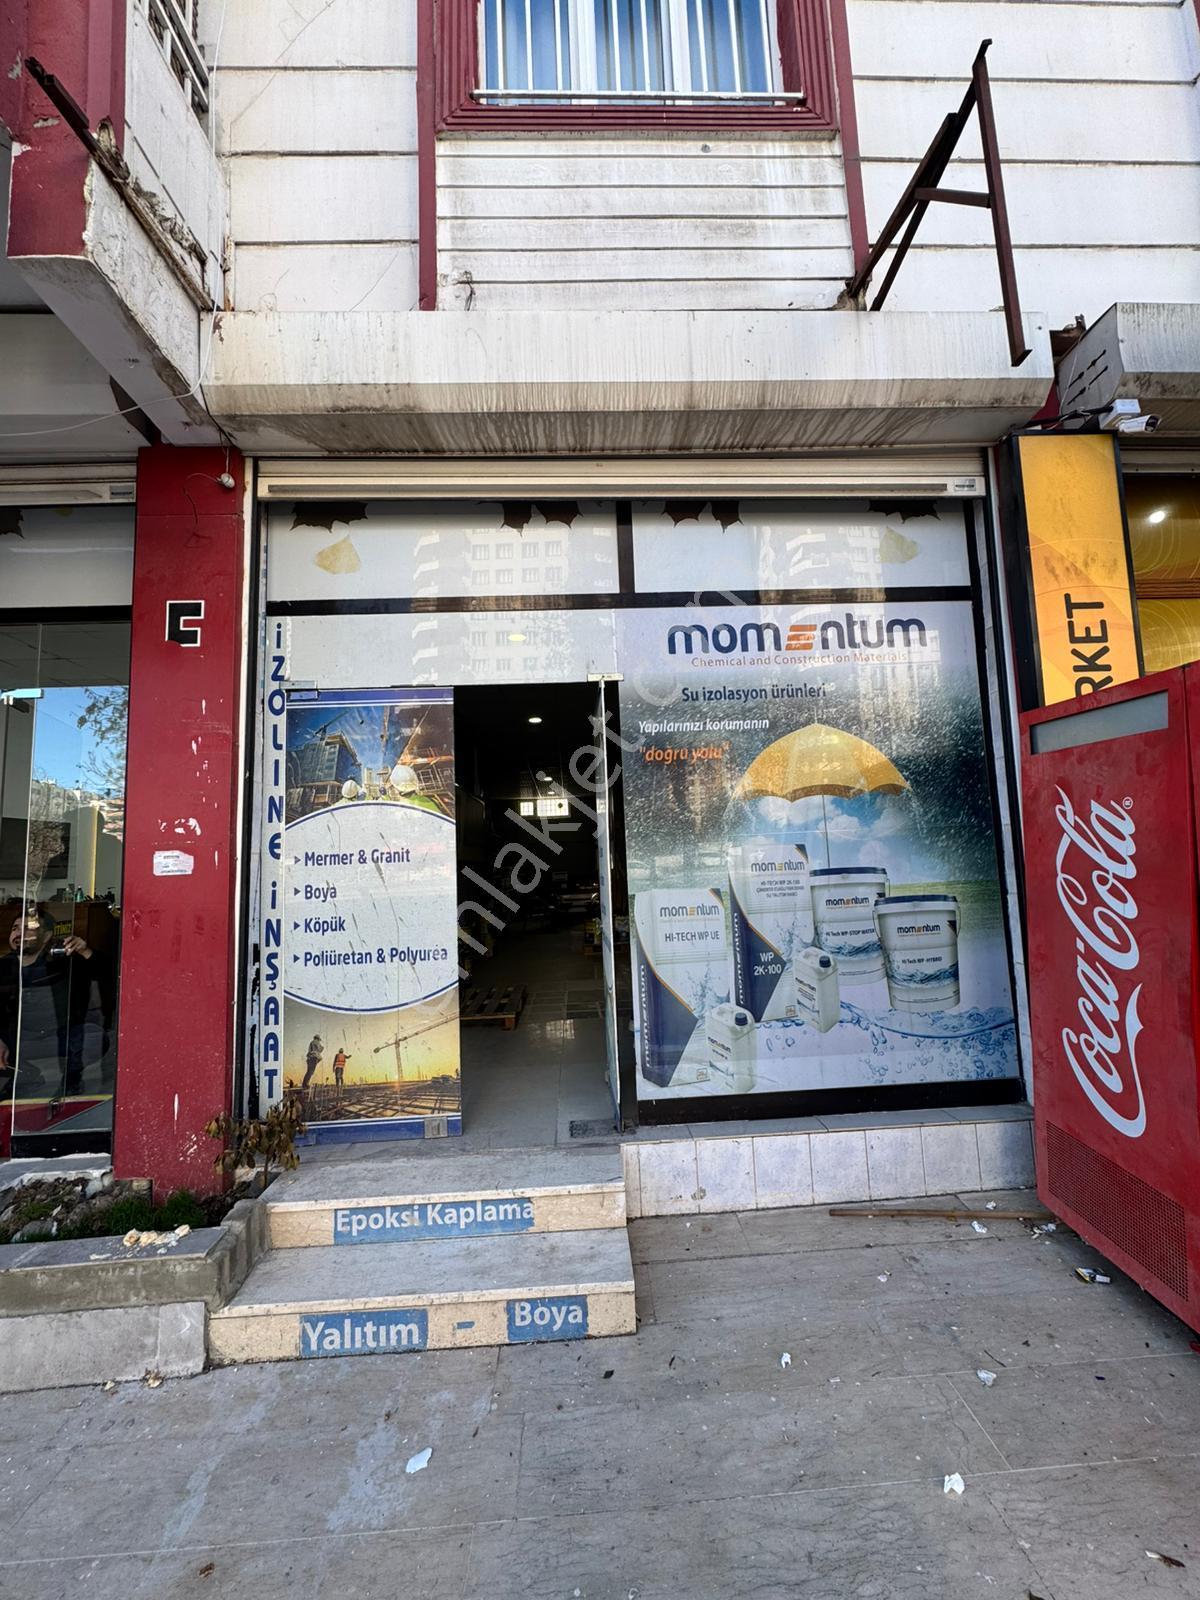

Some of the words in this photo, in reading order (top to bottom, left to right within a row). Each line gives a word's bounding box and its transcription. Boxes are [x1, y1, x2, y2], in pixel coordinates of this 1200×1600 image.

[668, 612, 928, 655] momentum
[691, 655, 747, 668] Chemical
[749, 655, 771, 667] and
[774, 653, 851, 666] Construction
[853, 652, 907, 664] Materials
[681, 687, 699, 702] Su
[702, 685, 768, 703] izolasyon
[771, 682, 827, 699] ürünleri
[638, 719, 704, 736] Yapılarınızı
[705, 718, 770, 731] korumanın
[304, 851, 354, 867] Mermer
[357, 850, 367, 864] &
[371, 847, 411, 864] Granit
[304, 884, 337, 903] Boya
[304, 916, 346, 936] Köpük
[664, 931, 697, 942] HI-TECH
[697, 931, 710, 941] WP
[710, 930, 720, 940] UE
[304, 950, 373, 967] Poliüretan
[376, 948, 386, 963] &
[759, 952, 775, 961] WP
[754, 966, 782, 976] 2K-100
[336, 1205, 419, 1237] Epoksi
[426, 1199, 535, 1229] Kaplama
[304, 1317, 420, 1352] Yalıtım
[514, 1301, 583, 1331] Boya
